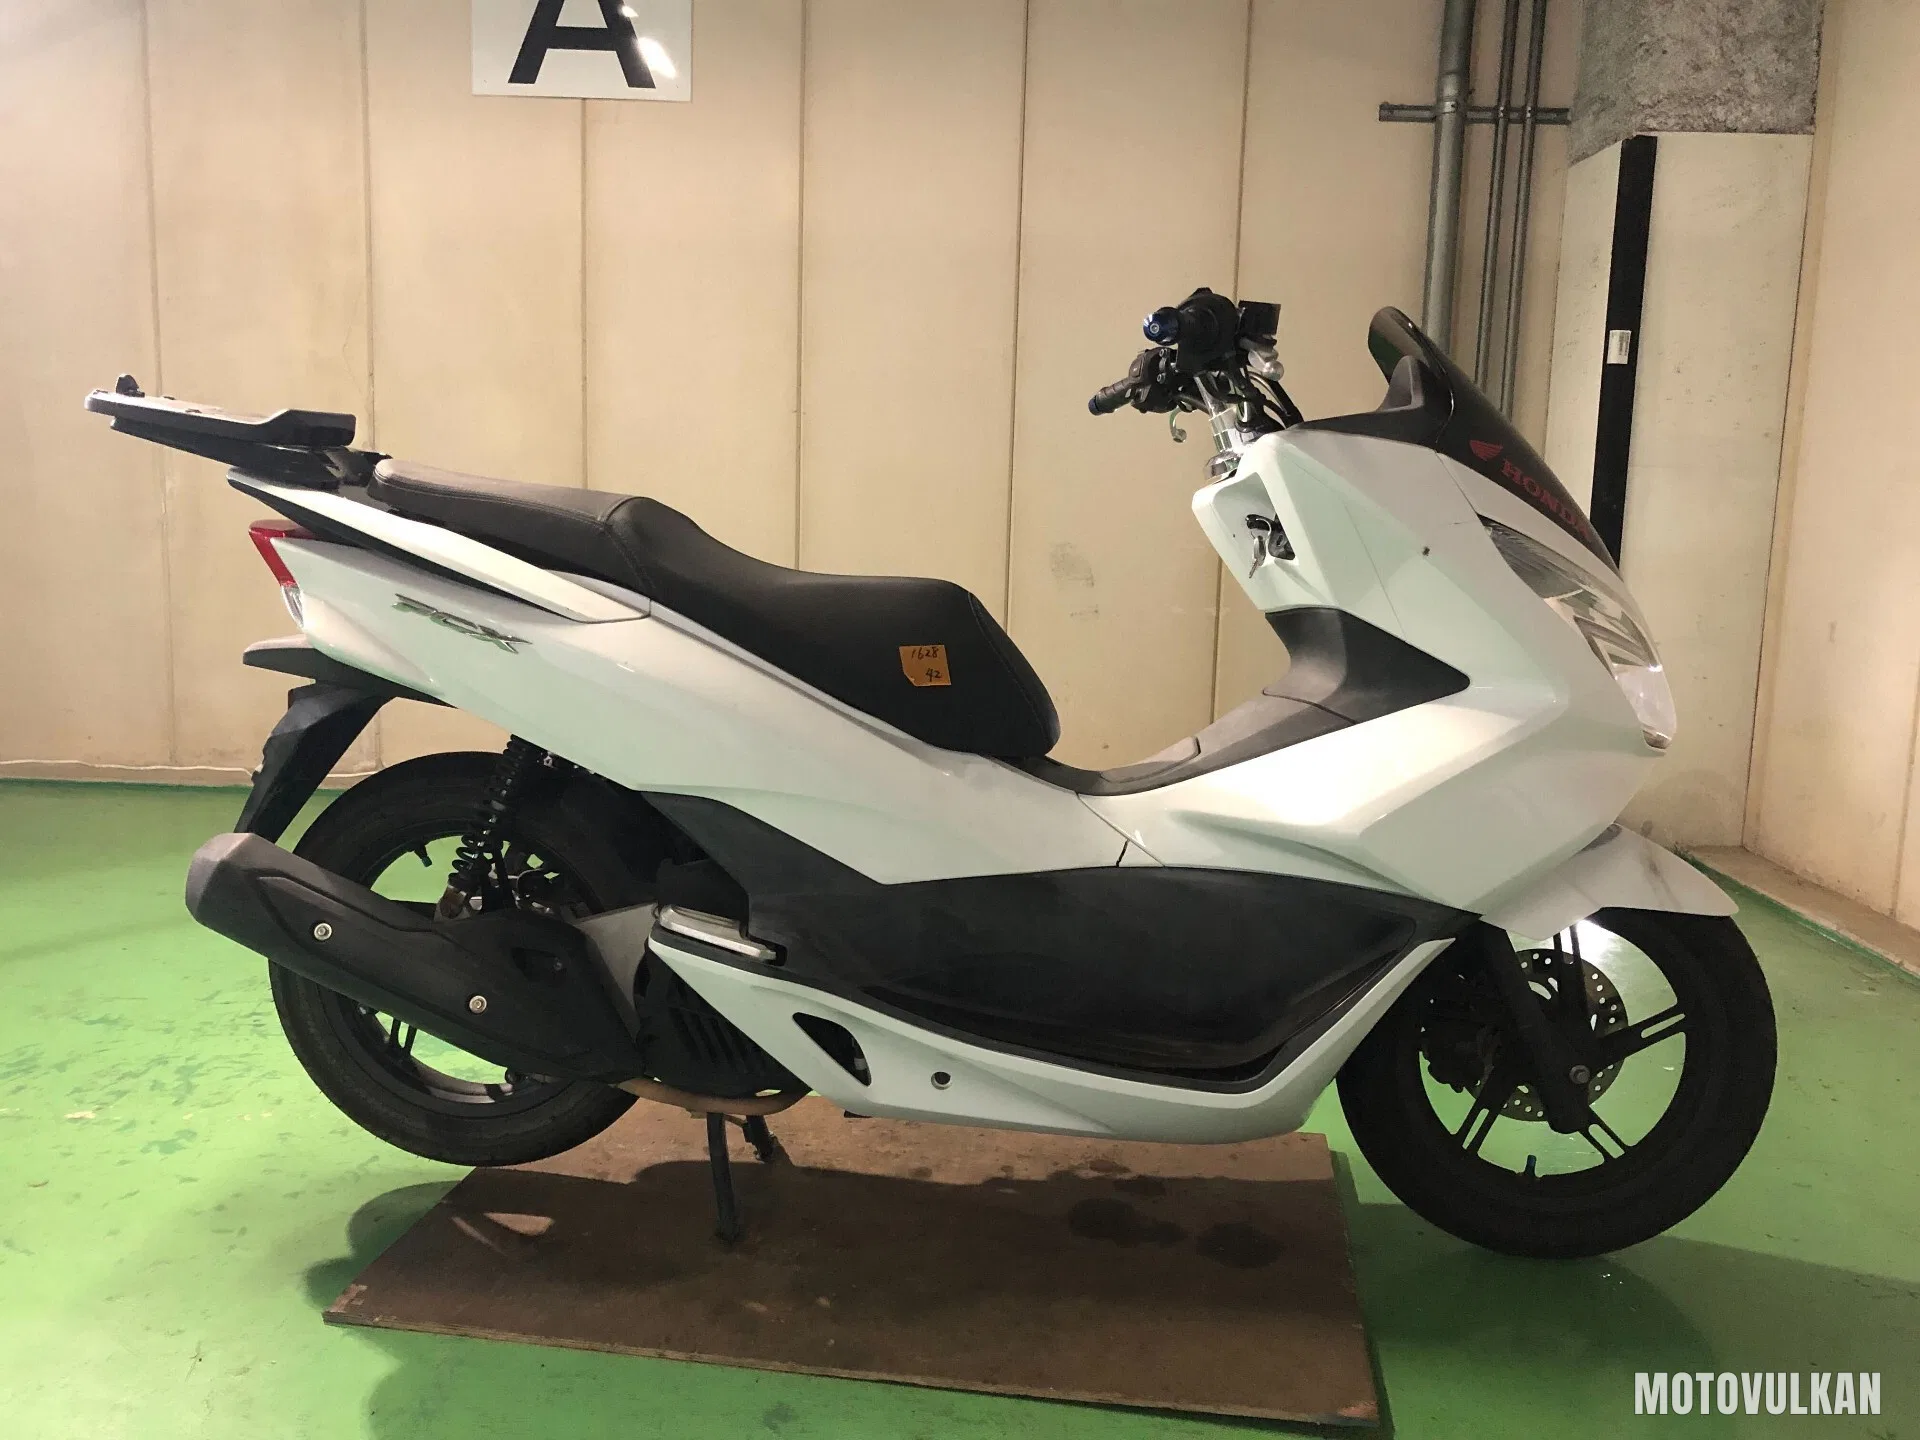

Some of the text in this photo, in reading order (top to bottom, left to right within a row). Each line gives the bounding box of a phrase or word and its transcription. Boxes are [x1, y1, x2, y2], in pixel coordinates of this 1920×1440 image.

[1501, 459, 1591, 541] HONDA
[911, 646, 939, 660] 1628
[925, 667, 943, 683] 42
